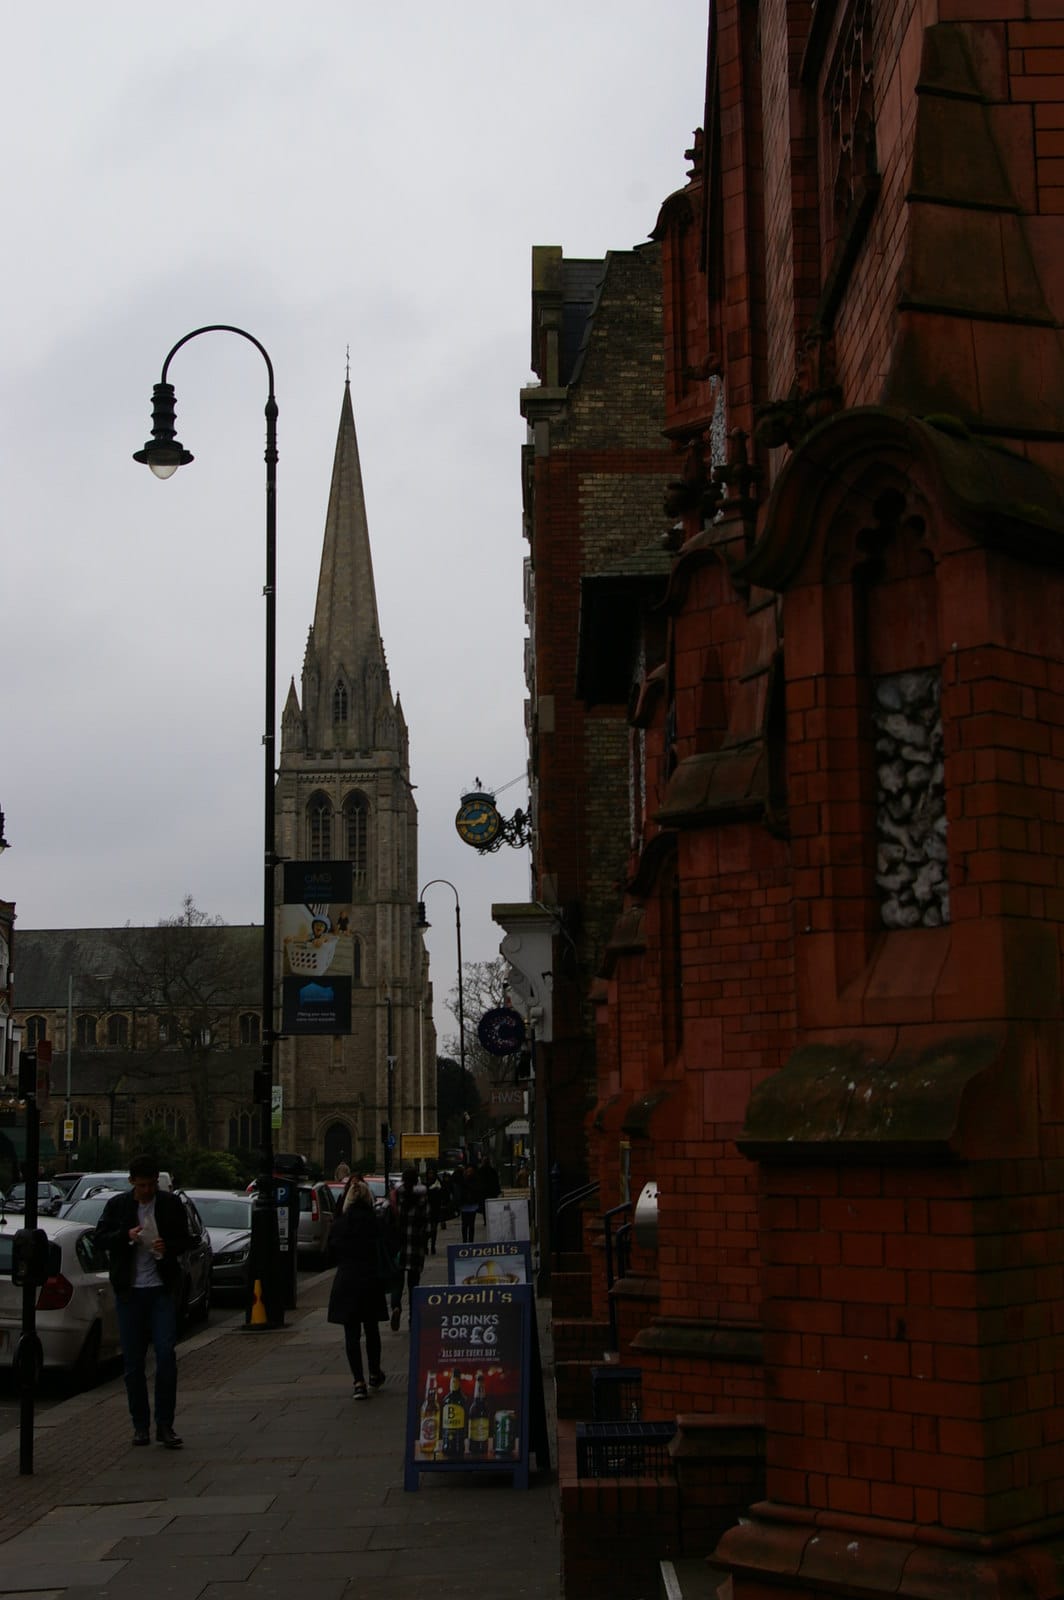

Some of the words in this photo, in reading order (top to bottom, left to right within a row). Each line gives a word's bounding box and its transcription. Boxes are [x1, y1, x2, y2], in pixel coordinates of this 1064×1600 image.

[277, 1187, 286, 1201] P
[440, 1315, 449, 1327] 2
[451, 1313, 500, 1326] DRINKS
[440, 1327, 468, 1340] FOR
[469, 1325, 498, 1345] £6
[453, 1349, 465, 1358] DAY
[465, 1348, 484, 1357] EVERY
[484, 1348, 497, 1357] DAY
